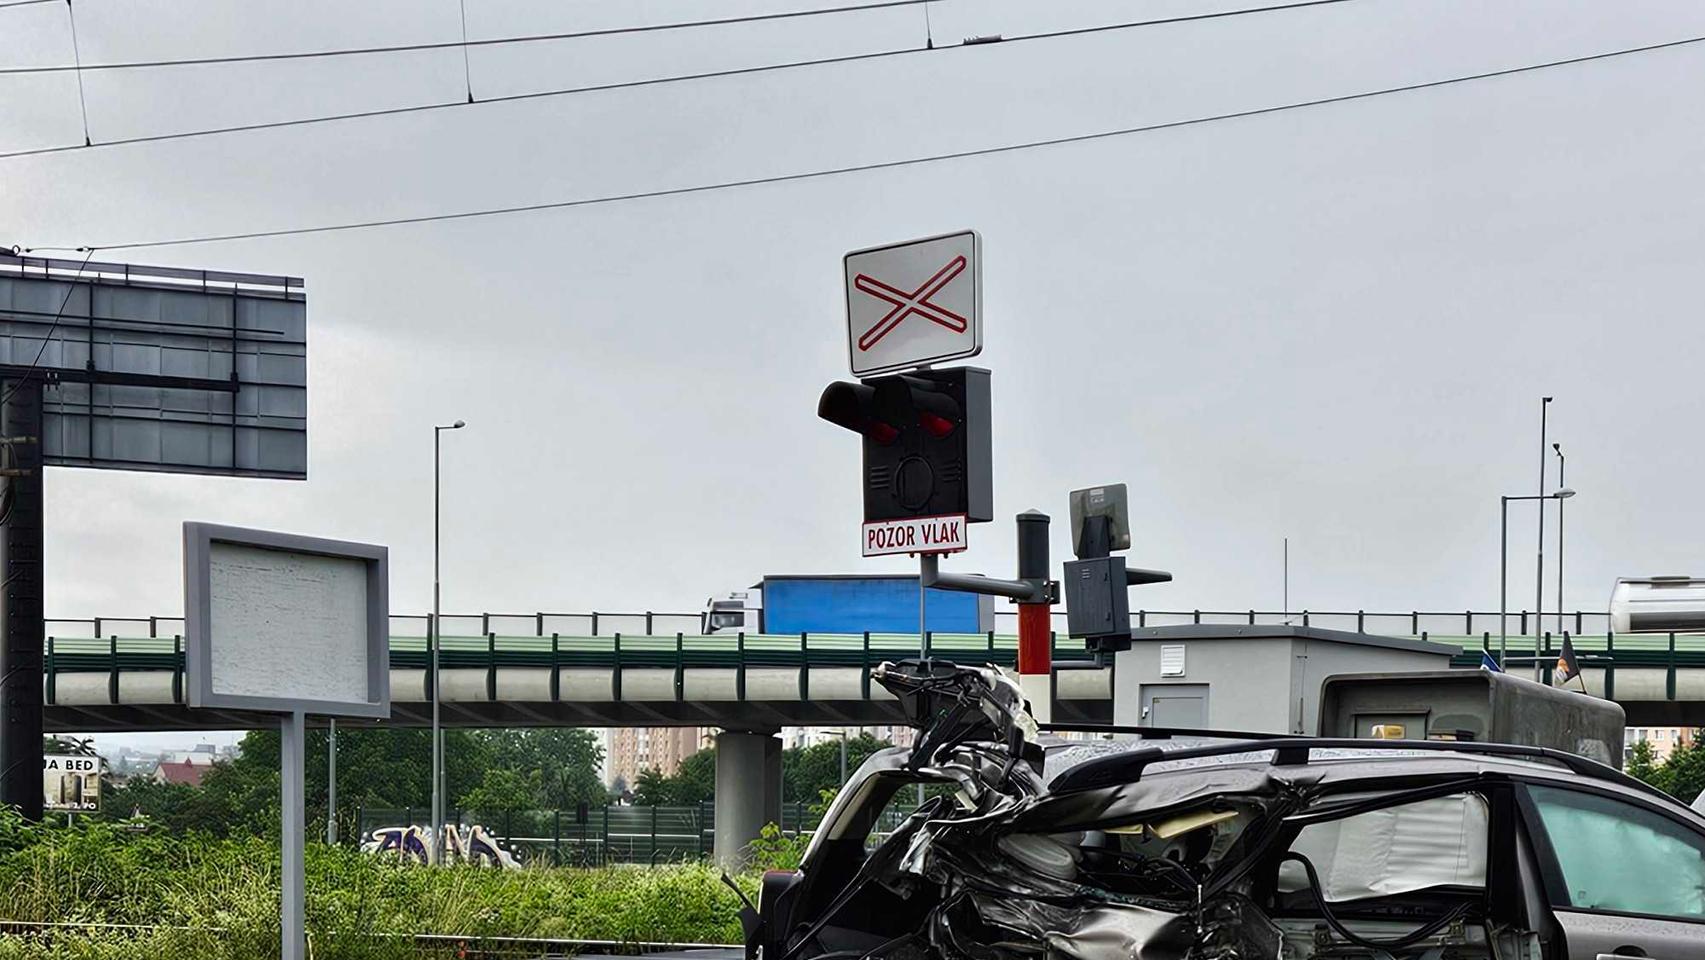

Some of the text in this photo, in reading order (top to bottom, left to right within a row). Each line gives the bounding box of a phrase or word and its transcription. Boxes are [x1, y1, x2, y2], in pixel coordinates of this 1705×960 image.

[868, 521, 959, 549] POZOR VLAK
[65, 760, 93, 771] BED
